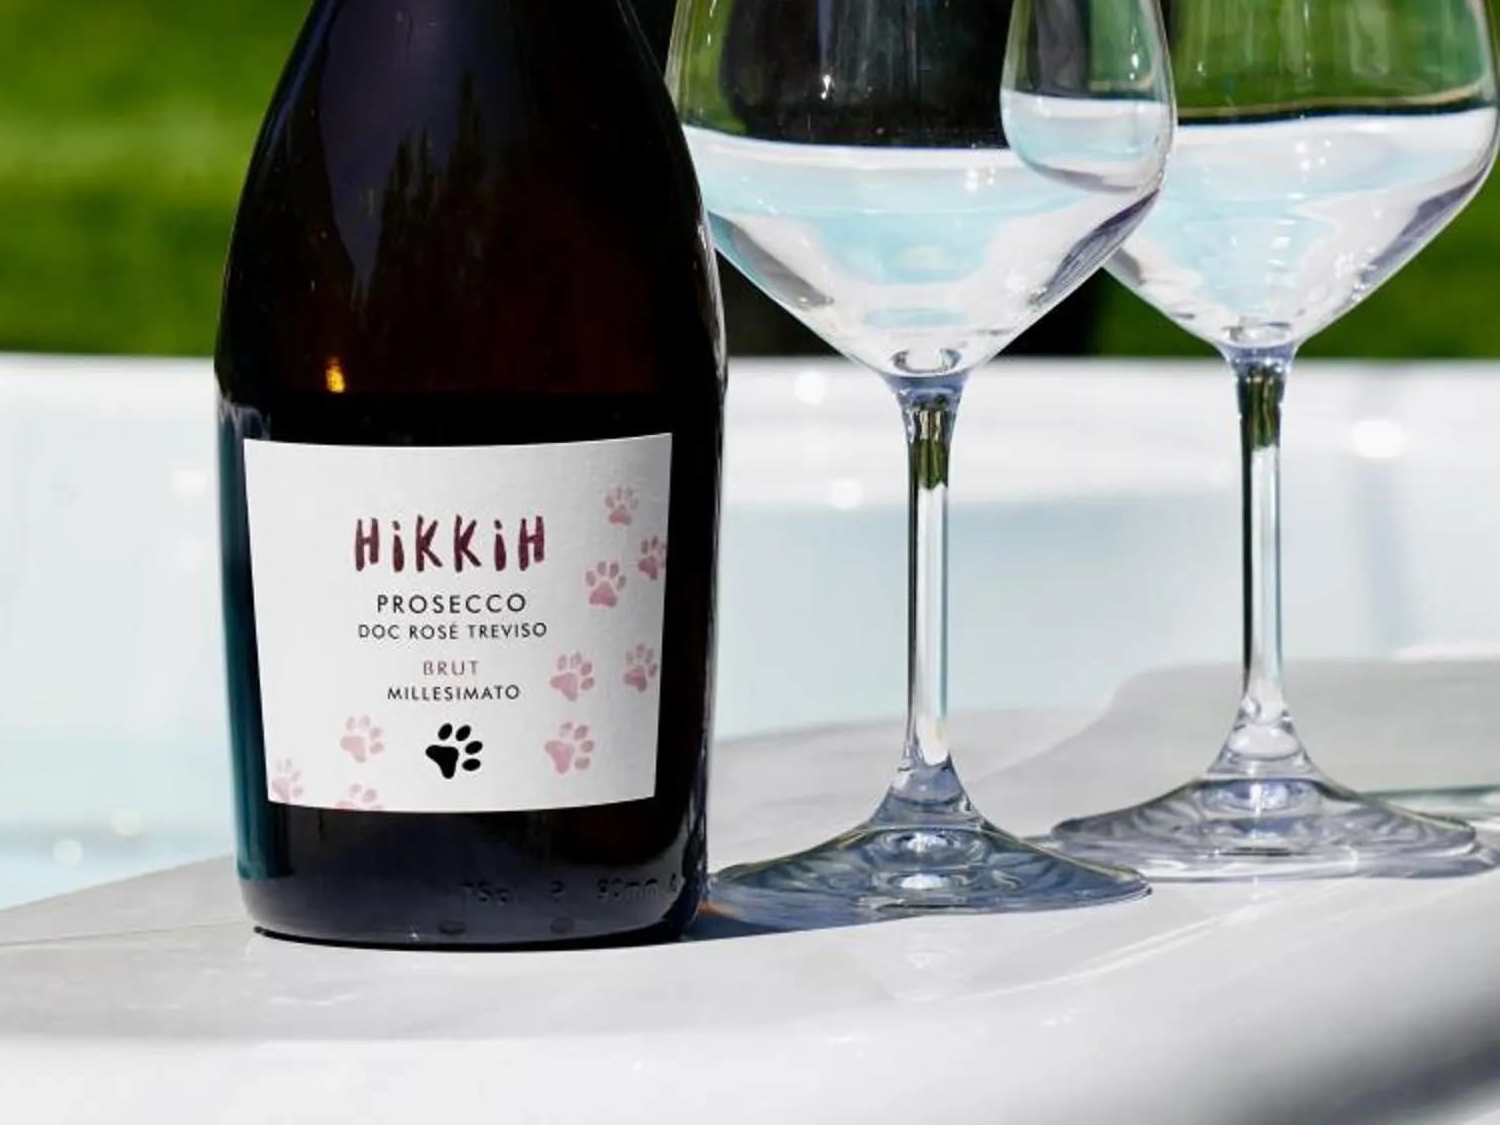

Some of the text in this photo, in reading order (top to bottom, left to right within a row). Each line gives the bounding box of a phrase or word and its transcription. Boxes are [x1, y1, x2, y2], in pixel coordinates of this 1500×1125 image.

[376, 593, 527, 614] PROSECCO
[357, 621, 547, 640] DOC ROSÉ TREVISO
[423, 659, 480, 676] BRUT
[387, 684, 520, 701] MILLESIMATO
